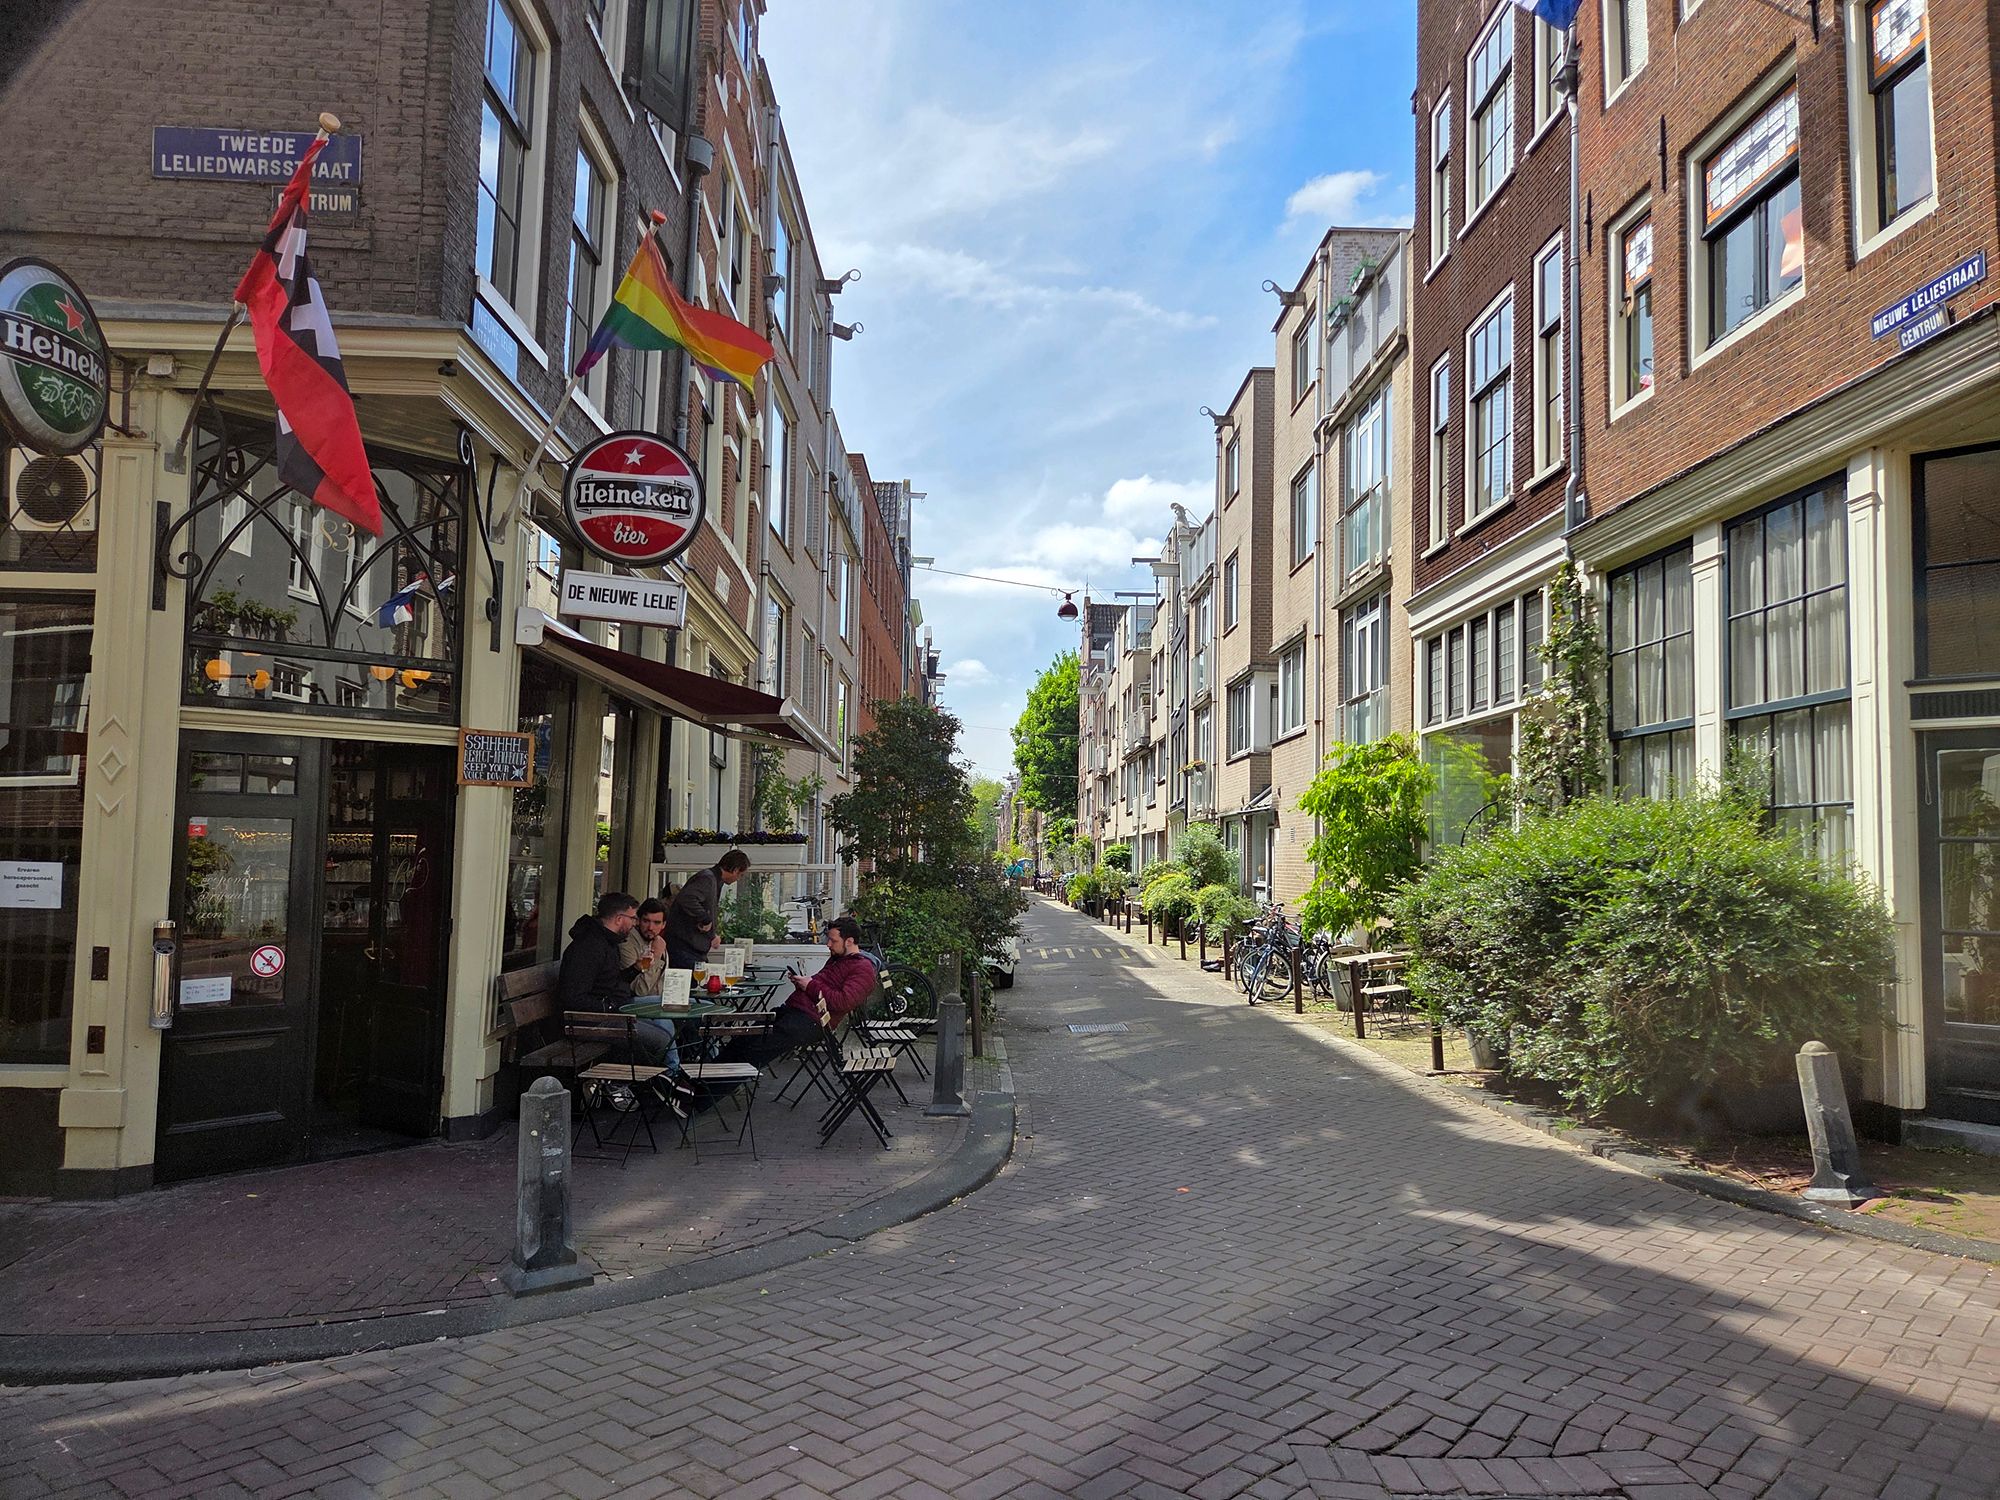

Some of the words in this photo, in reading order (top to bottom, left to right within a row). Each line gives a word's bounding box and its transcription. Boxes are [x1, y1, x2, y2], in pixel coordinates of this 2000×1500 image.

[219, 135, 296, 155] TWEEDE
[277, 192, 352, 212] CTRUM
[1873, 302, 1910, 335] NIEUWE
[1911, 259, 1980, 313] LELIESTRAAT
[1900, 309, 1945, 347] CENTRUM
[5, 318, 105, 390] Heineke
[579, 483, 688, 511] Heineken
[313, 519, 356, 553] 83
[613, 522, 649, 546] bier
[568, 584, 585, 600] DE
[588, 587, 639, 607] NIEUWE
[643, 592, 678, 611] LELIE
[464, 762, 487, 771] KEEP
[489, 763, 510, 772] YOUR
[464, 771, 484, 779] VOICE
[487, 772, 509, 781] DOWN
